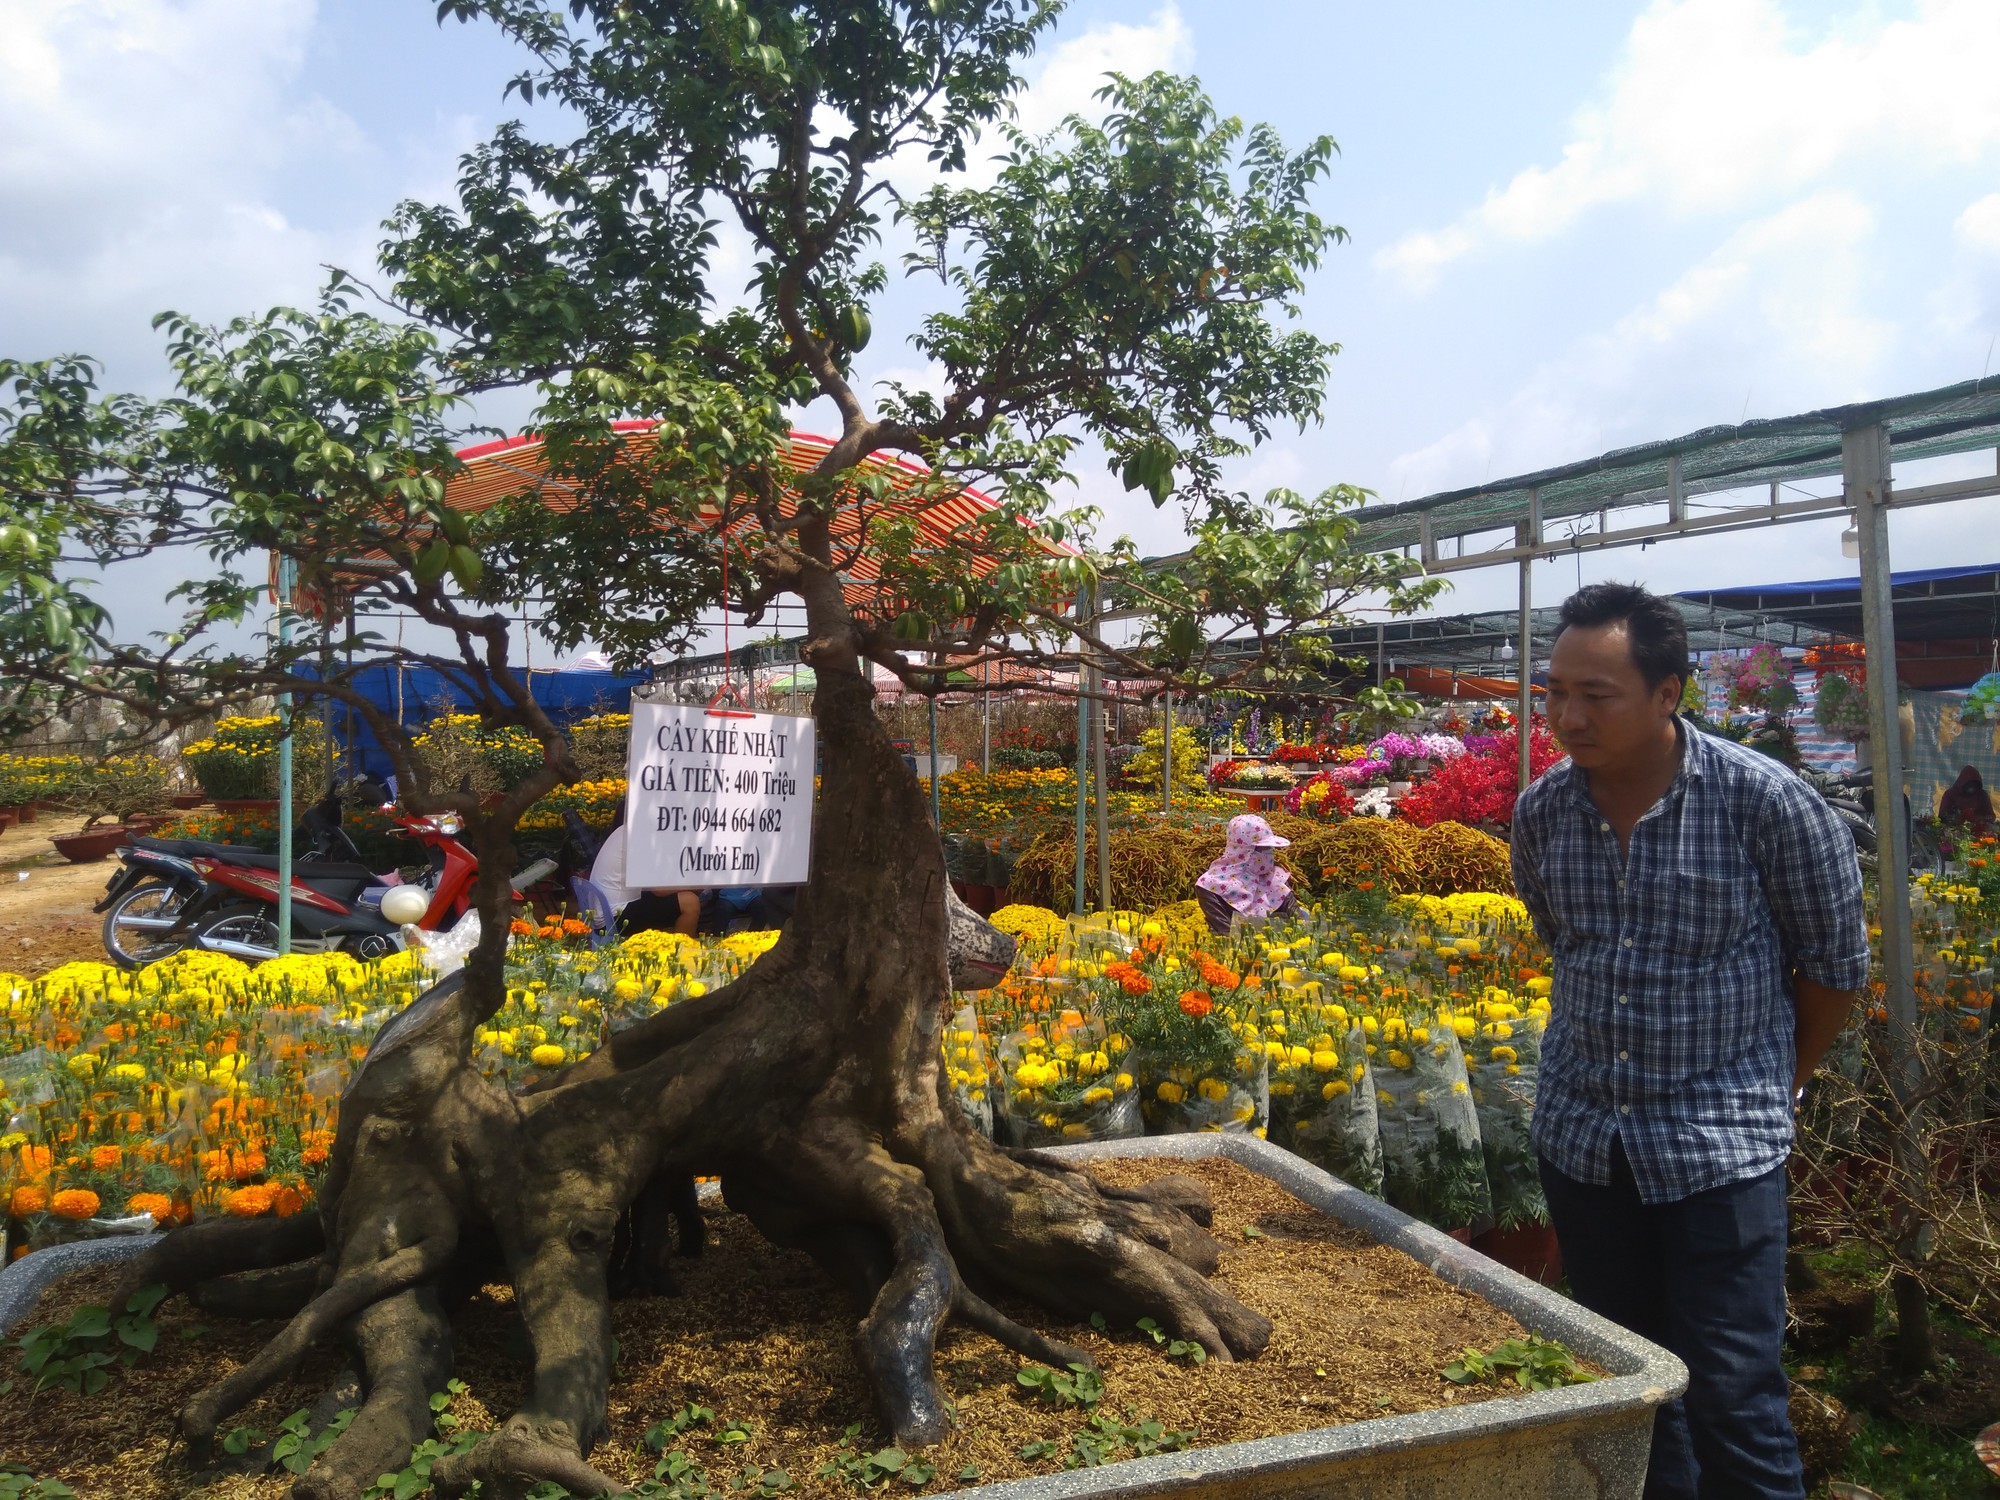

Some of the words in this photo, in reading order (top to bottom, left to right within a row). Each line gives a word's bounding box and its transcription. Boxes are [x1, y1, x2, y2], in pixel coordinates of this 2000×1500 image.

[657, 718, 698, 753] CÂY
[701, 722, 739, 755] KHẾ
[743, 729, 788, 764] NHẬT
[641, 759, 677, 792] GIÁ
[682, 760, 730, 794] TIỀN:
[734, 770, 759, 795] 400
[762, 771, 796, 802] Triệu
[656, 806, 687, 832] ĐT:
[692, 806, 727, 832] 0944
[731, 807, 755, 832] 664
[759, 808, 782, 832] 682
[679, 845, 727, 878] (Mười
[731, 845, 761, 877] Em)
